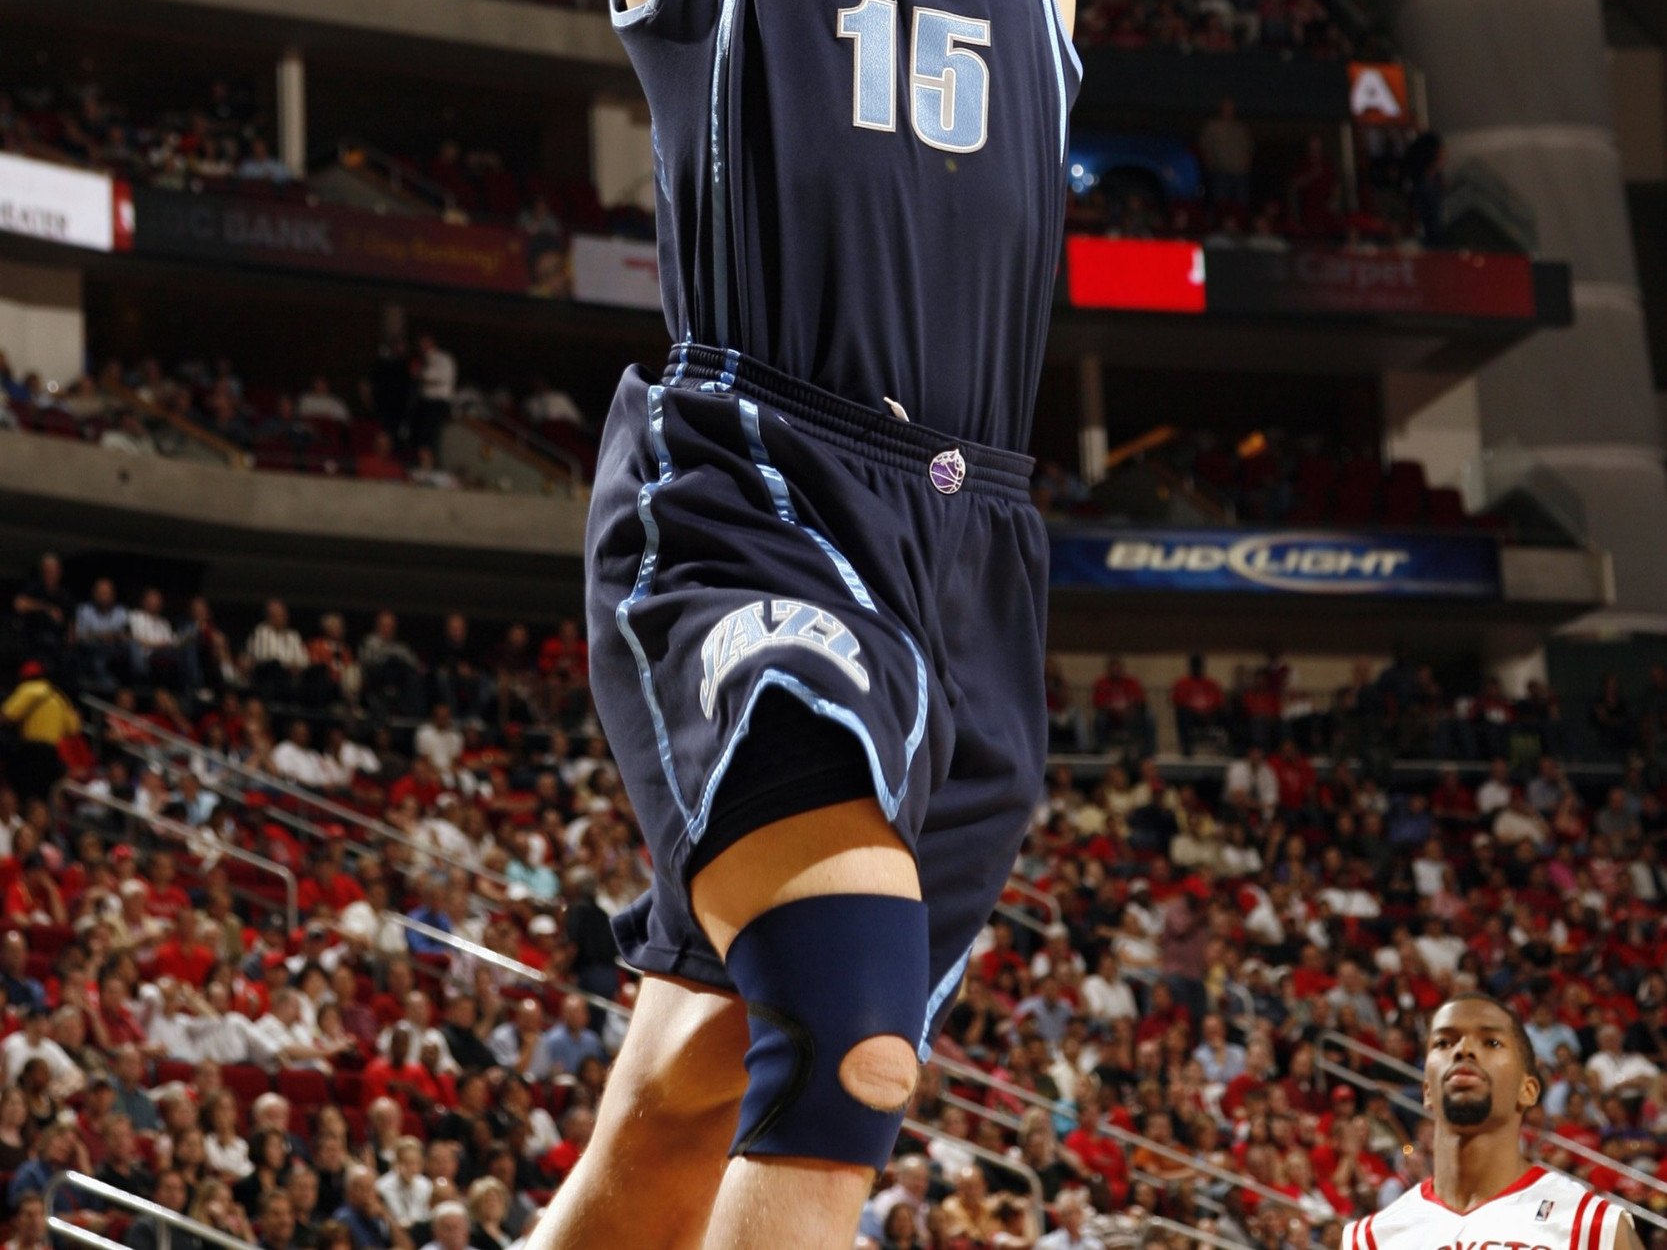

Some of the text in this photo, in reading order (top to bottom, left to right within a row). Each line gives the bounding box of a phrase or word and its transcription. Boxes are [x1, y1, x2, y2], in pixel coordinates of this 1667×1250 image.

[1350, 67, 1401, 117] A
[1296, 251, 1414, 288] Carpet
[1106, 540, 1411, 577] BUD LIGHT
[699, 599, 871, 721] JAZZ
